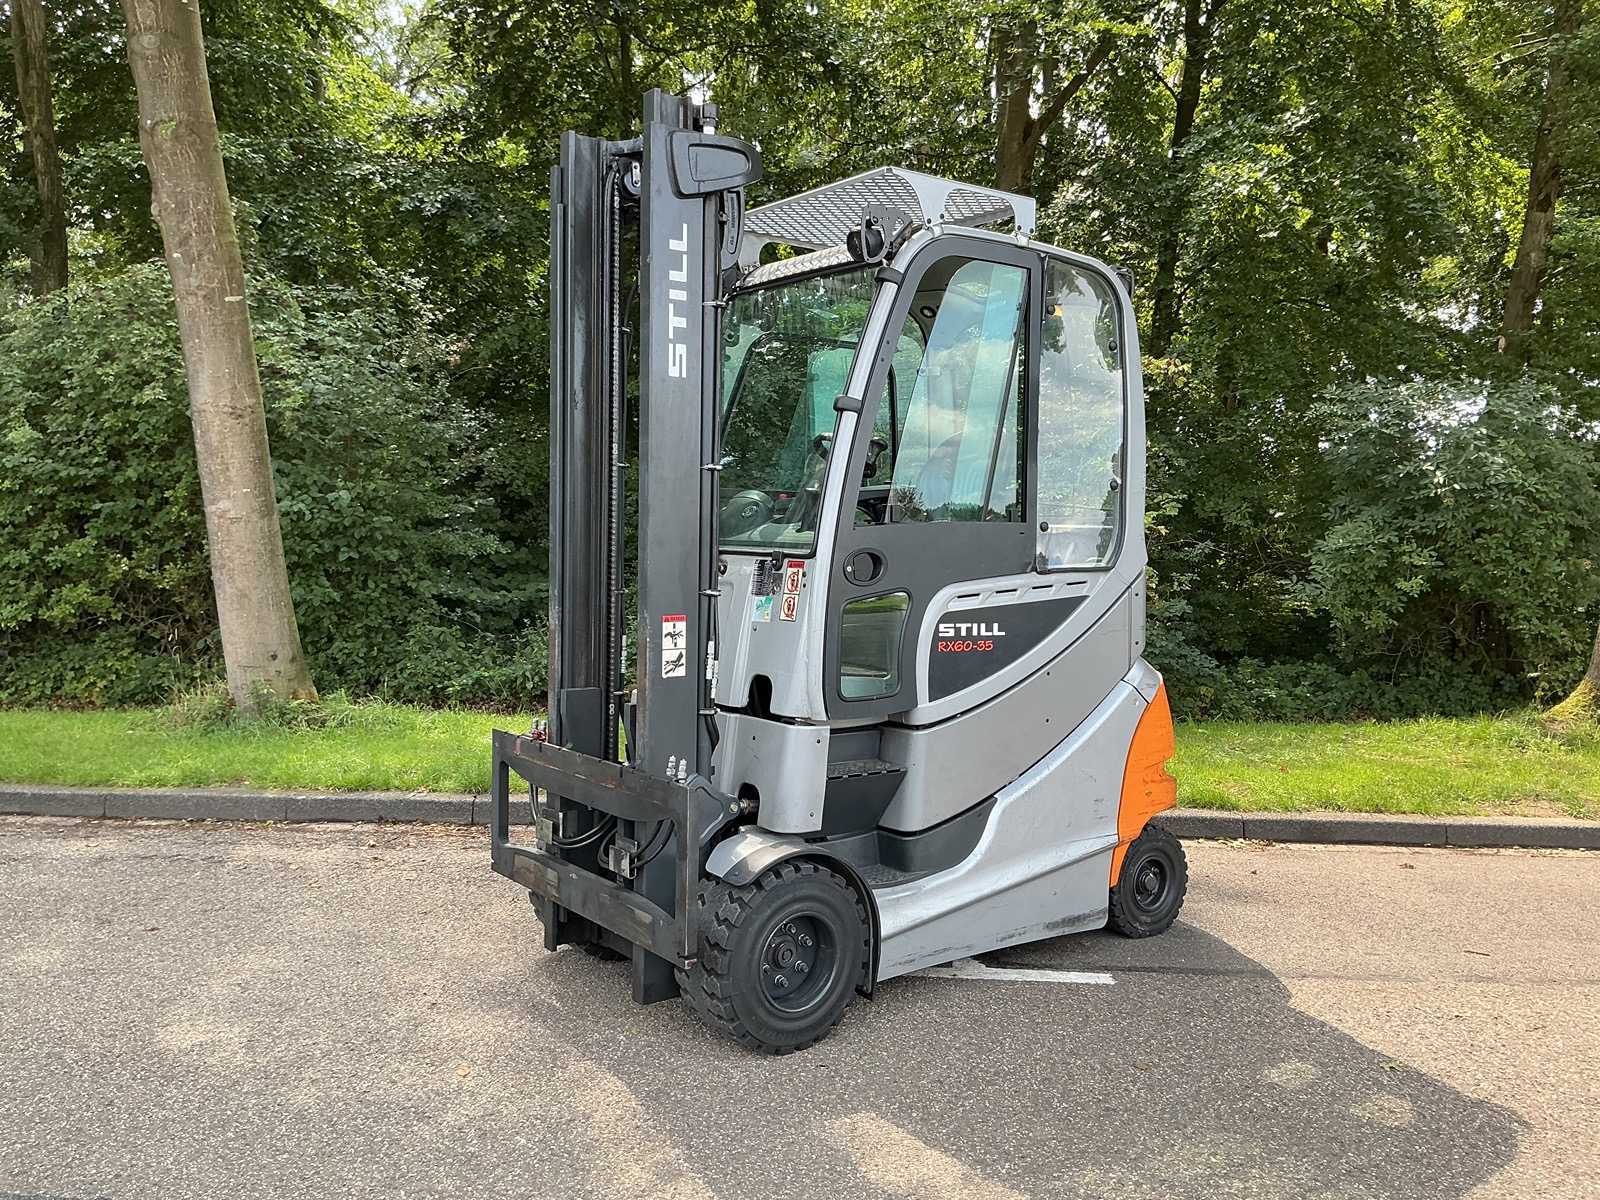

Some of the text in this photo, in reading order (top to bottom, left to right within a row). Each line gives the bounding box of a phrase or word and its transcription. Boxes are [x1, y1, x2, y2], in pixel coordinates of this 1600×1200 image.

[668, 223, 688, 379] STILL
[938, 623, 1006, 637] STILL
[938, 640, 994, 652] RX60-35
